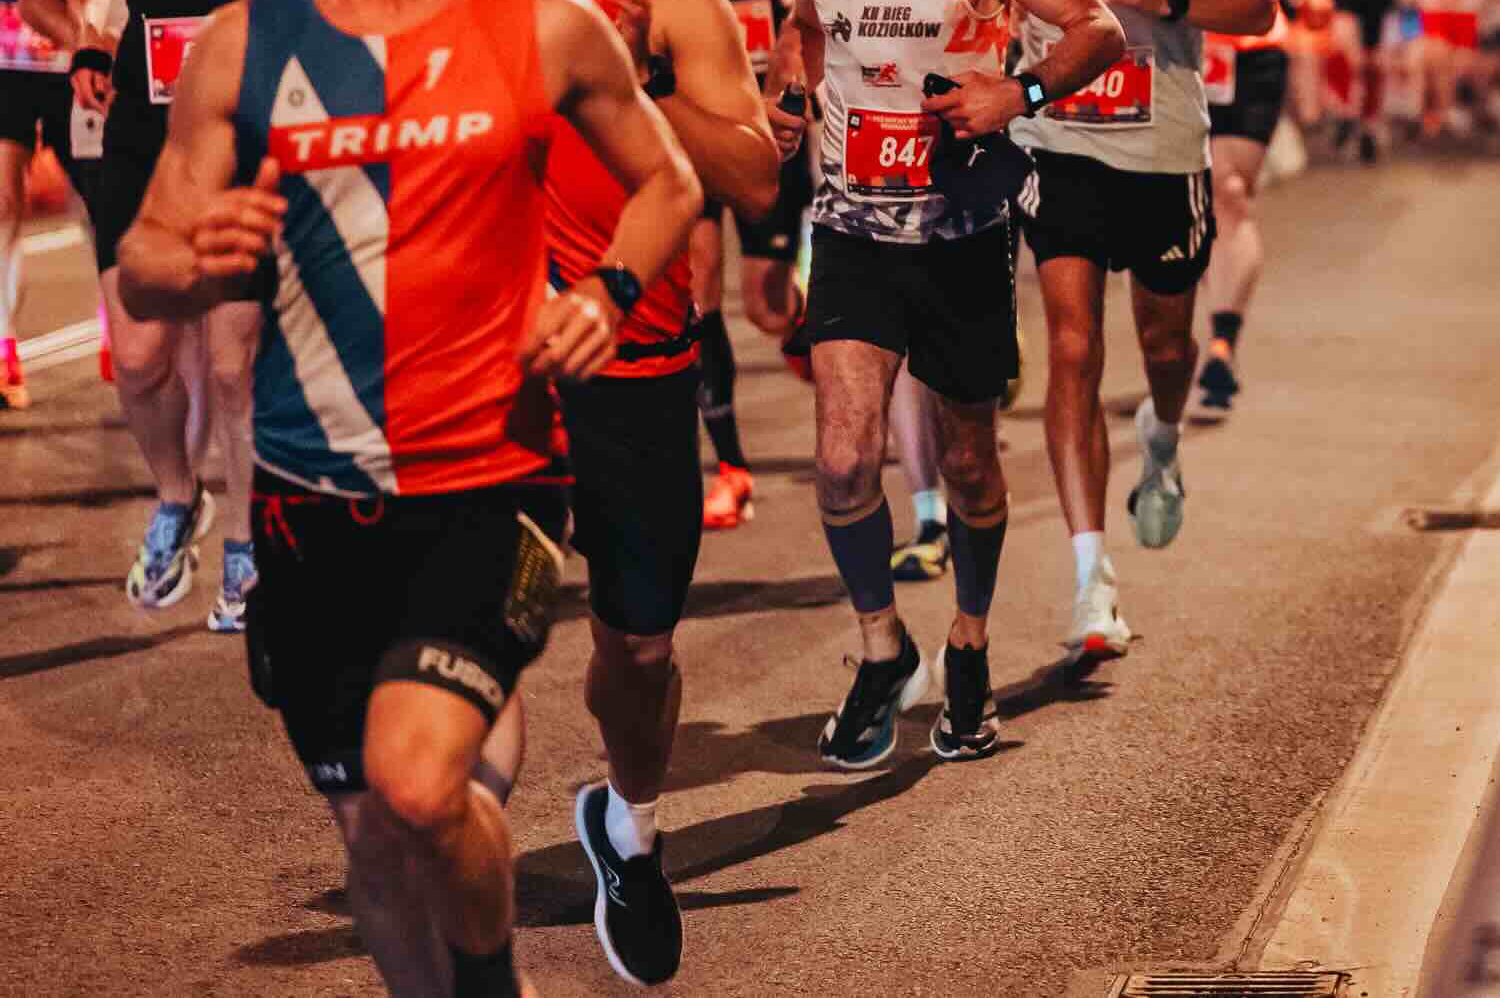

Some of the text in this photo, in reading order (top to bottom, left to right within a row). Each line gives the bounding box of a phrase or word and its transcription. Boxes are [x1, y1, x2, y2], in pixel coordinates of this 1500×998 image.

[882, 6, 912, 21] BIEG
[288, 111, 494, 162] TRIMP
[879, 136, 934, 168] 847
